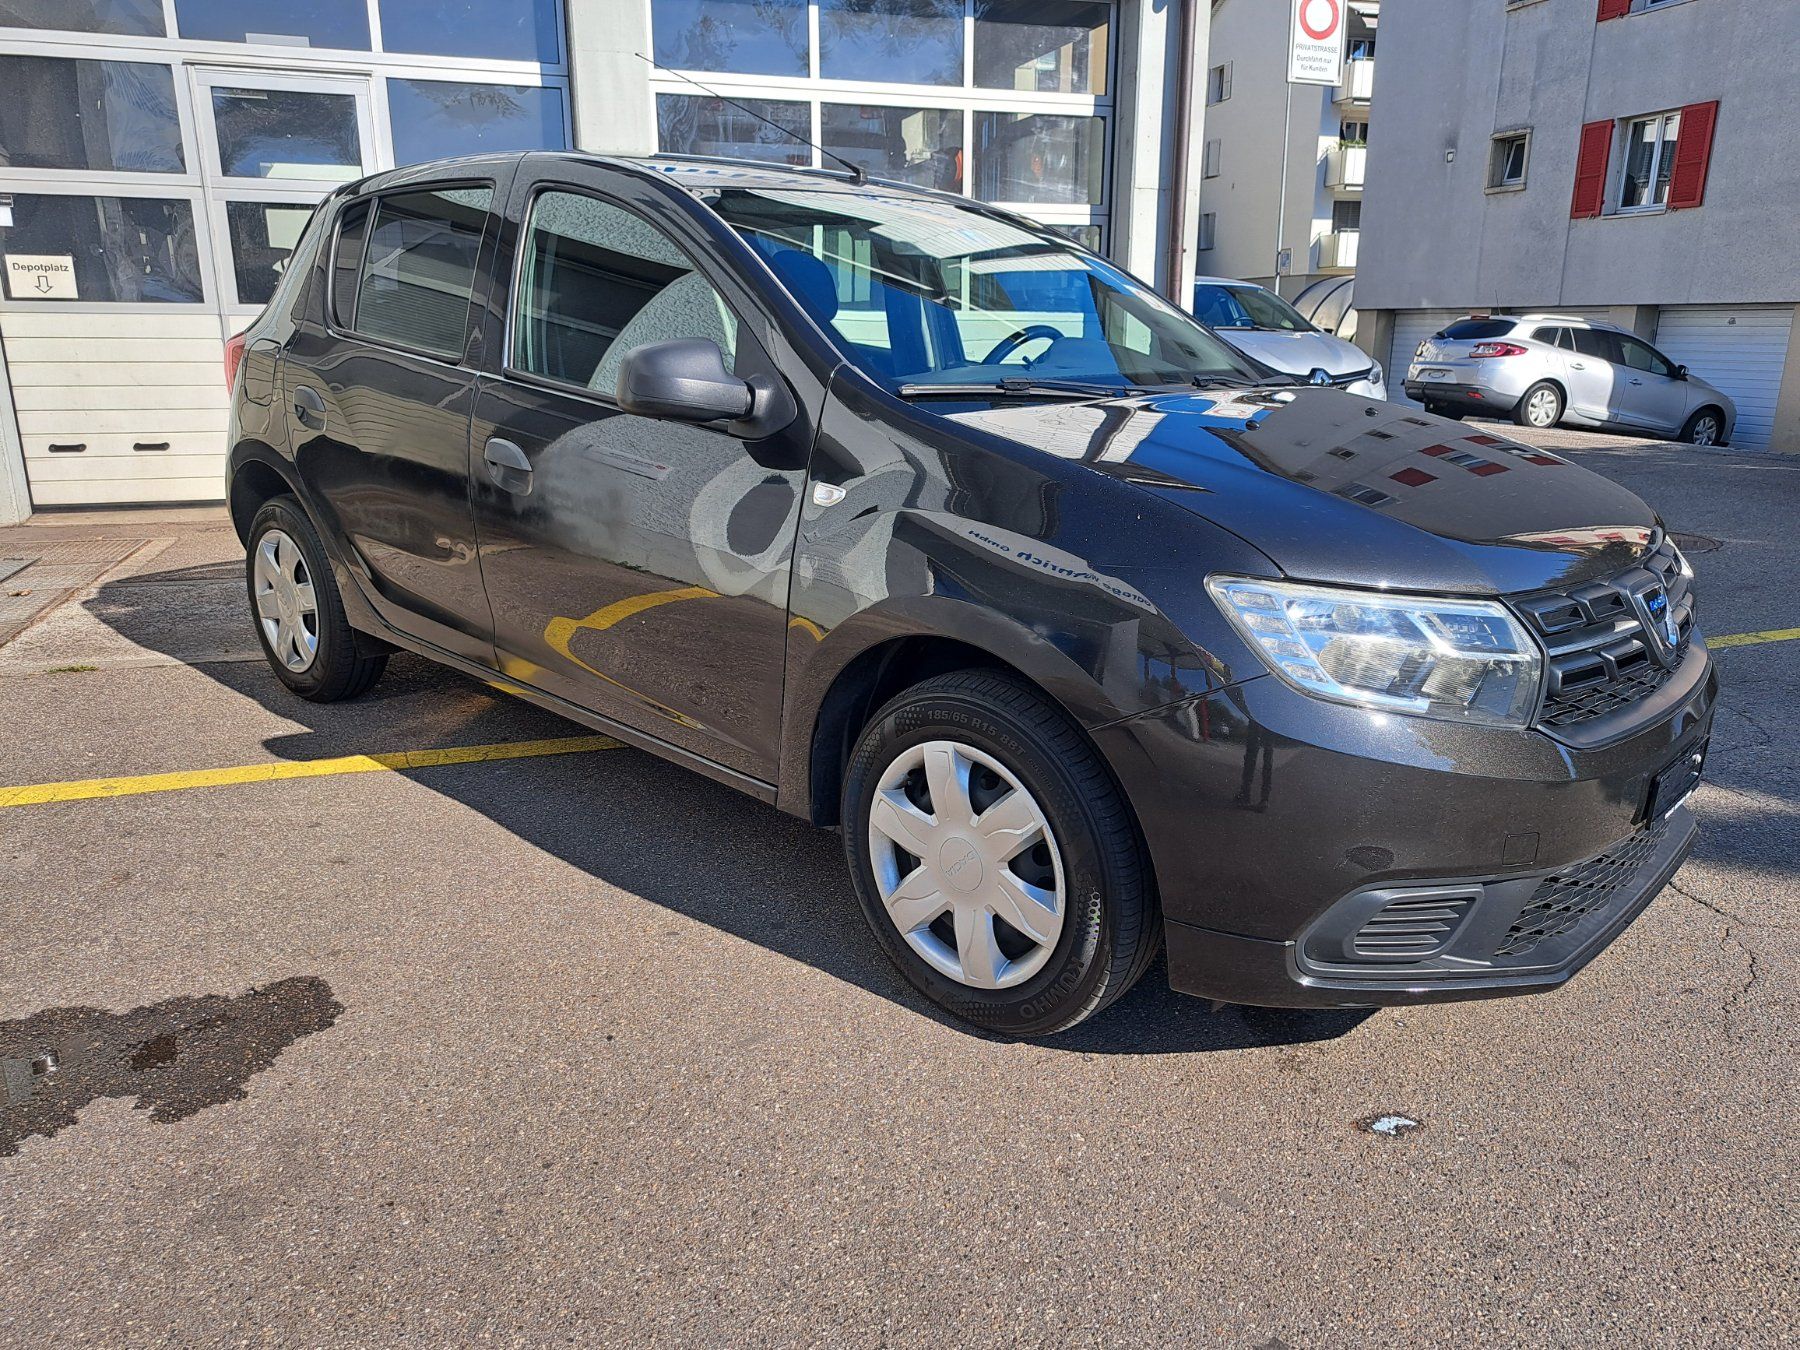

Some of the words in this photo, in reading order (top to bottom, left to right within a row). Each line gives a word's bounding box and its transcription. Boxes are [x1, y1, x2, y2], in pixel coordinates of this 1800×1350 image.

[1296, 43, 1338, 53] PRIVATSTRASSE
[12, 262, 69, 273] Depotplatz
[927, 710, 968, 724] 185/65
[971, 717, 998, 736] R15
